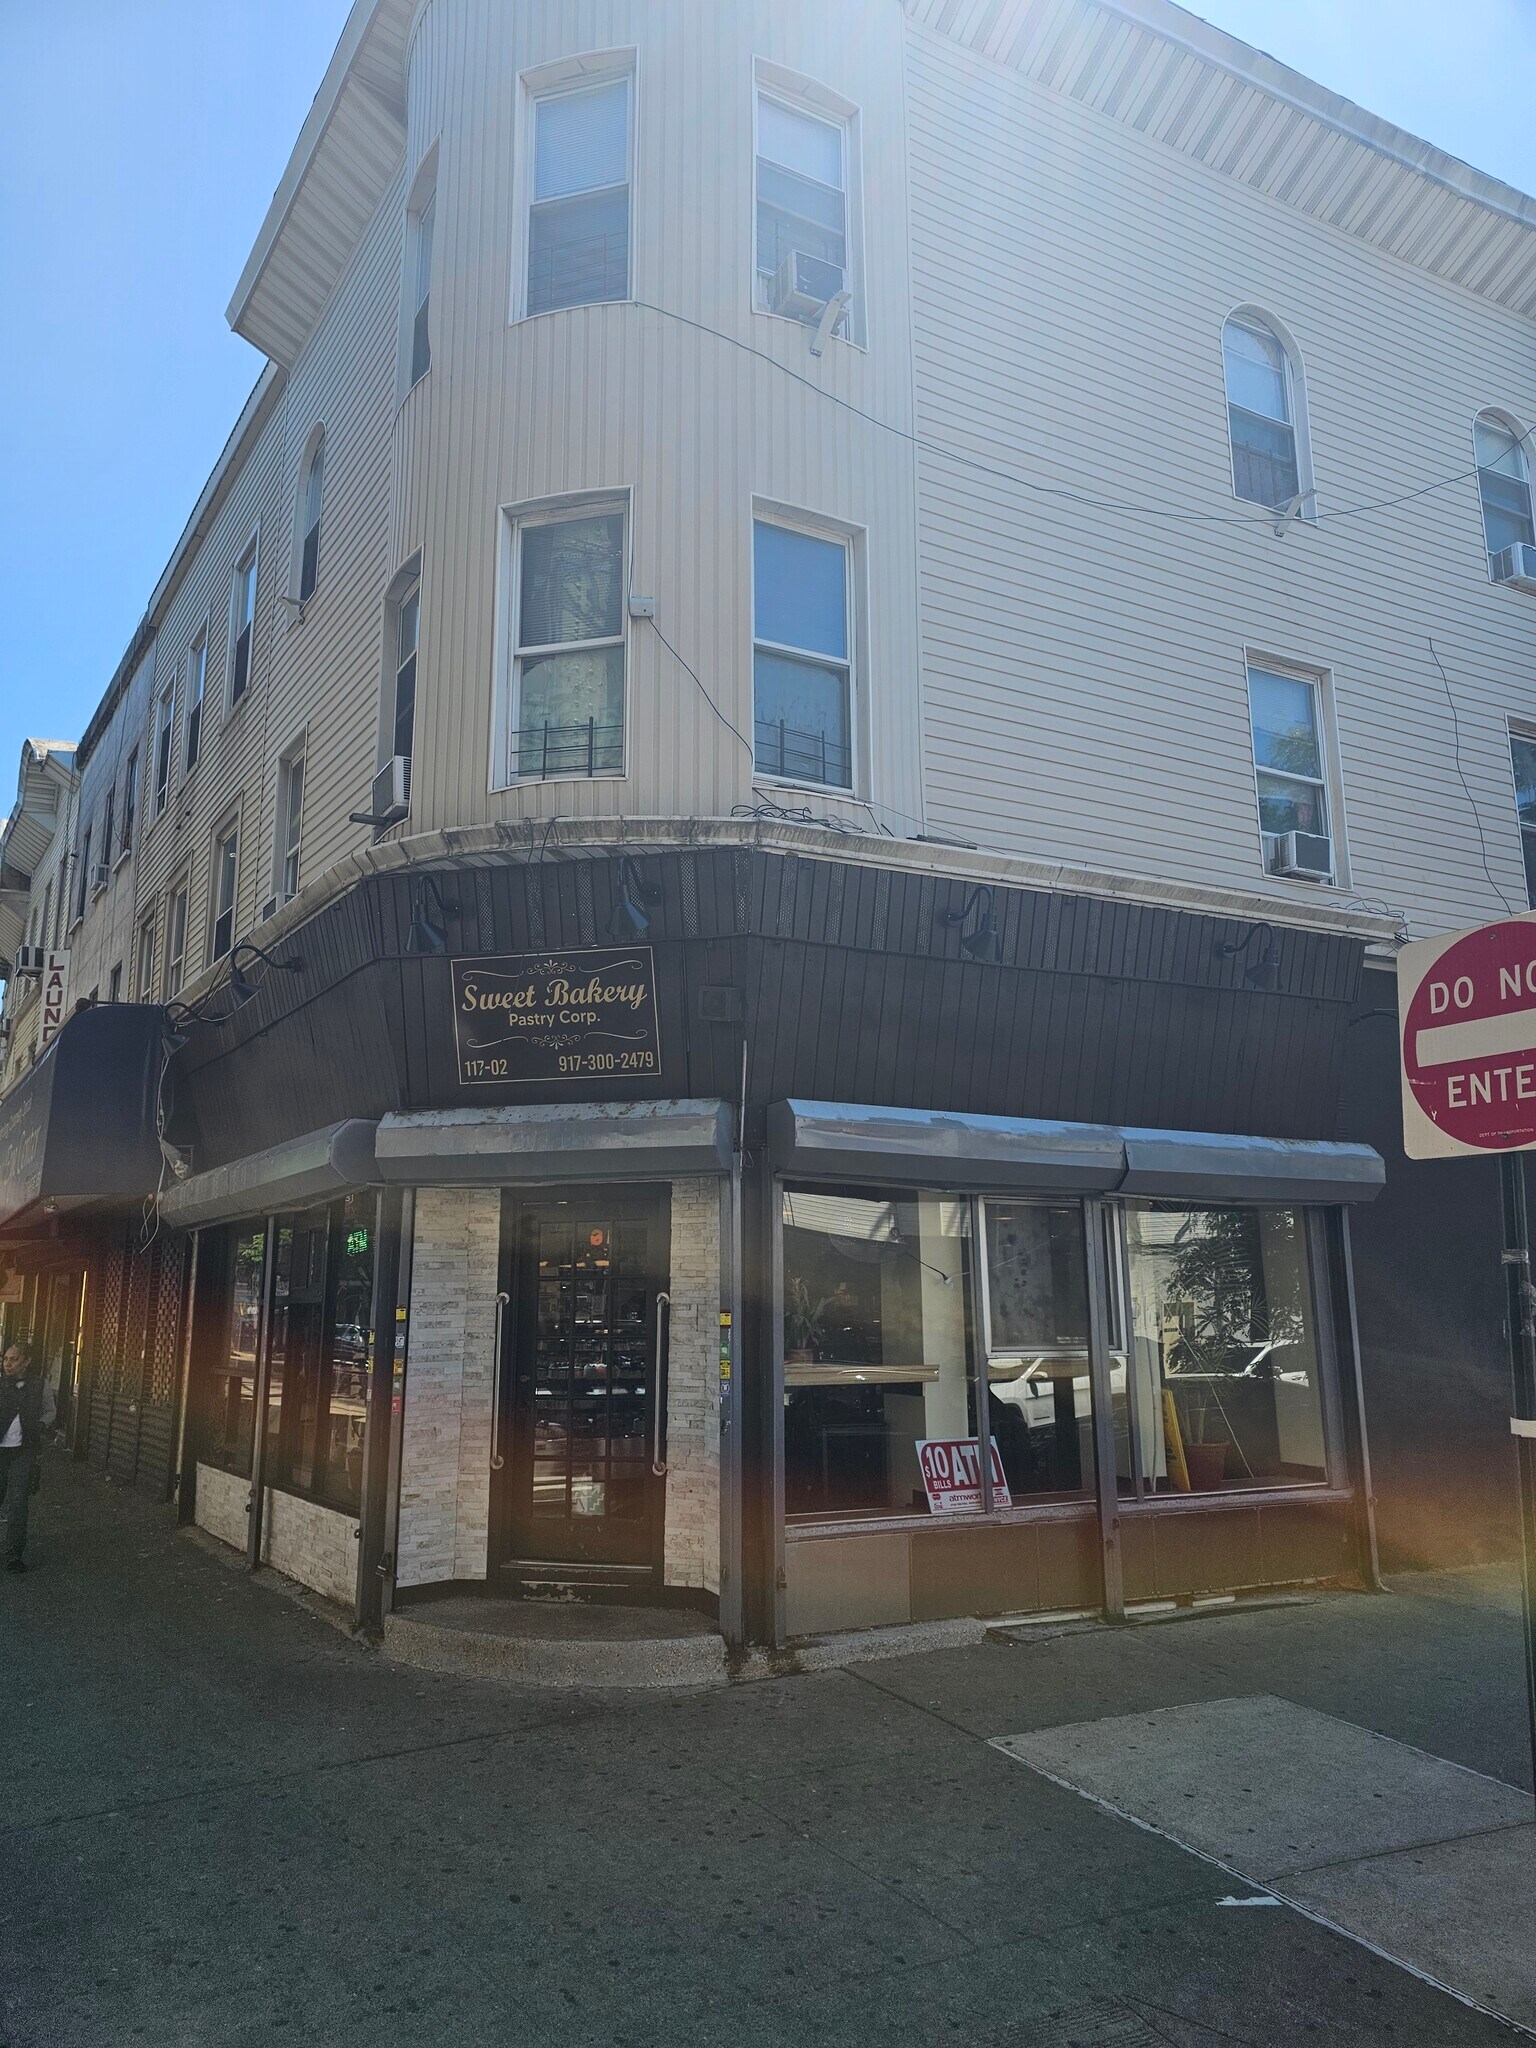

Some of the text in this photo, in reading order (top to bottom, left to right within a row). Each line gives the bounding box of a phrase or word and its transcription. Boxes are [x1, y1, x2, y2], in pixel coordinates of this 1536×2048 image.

[461, 977, 648, 1011] Sweet Bakery
[1430, 976, 1474, 1014] DO
[509, 1010, 601, 1027] Pastry Corp.
[464, 1059, 508, 1077] 117-02
[558, 1051, 654, 1072] 917-300-2479
[933, 1479, 952, 1490] BILLS
